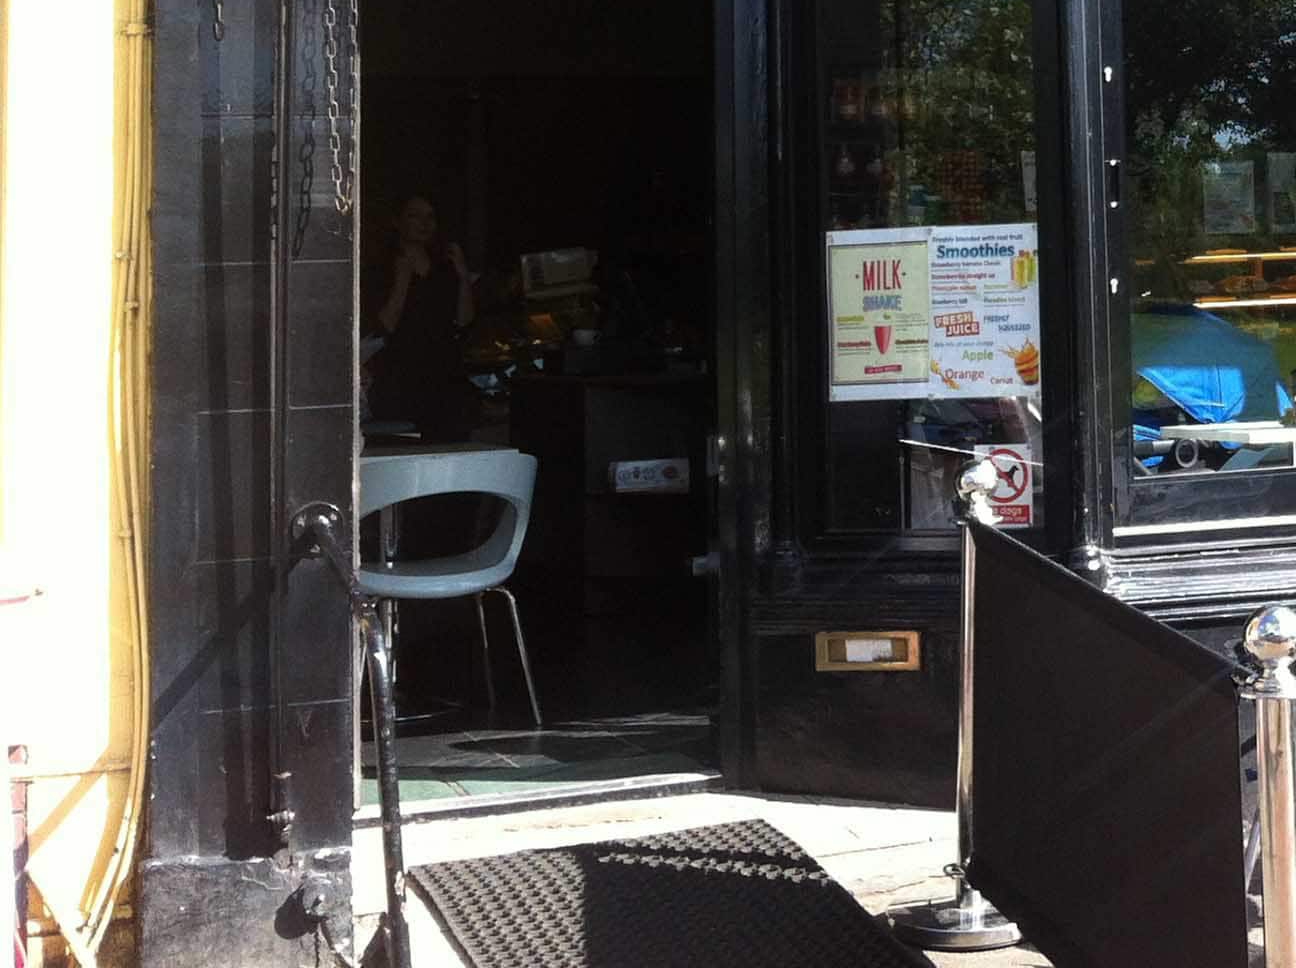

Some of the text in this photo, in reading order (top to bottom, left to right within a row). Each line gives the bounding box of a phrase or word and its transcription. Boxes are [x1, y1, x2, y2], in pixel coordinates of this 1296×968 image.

[937, 243, 1015, 259] Smoothies
[863, 260, 902, 291] MILK
[947, 322, 978, 336] JUICE
[961, 348, 994, 362] Apple
[945, 368, 985, 381] Orange
